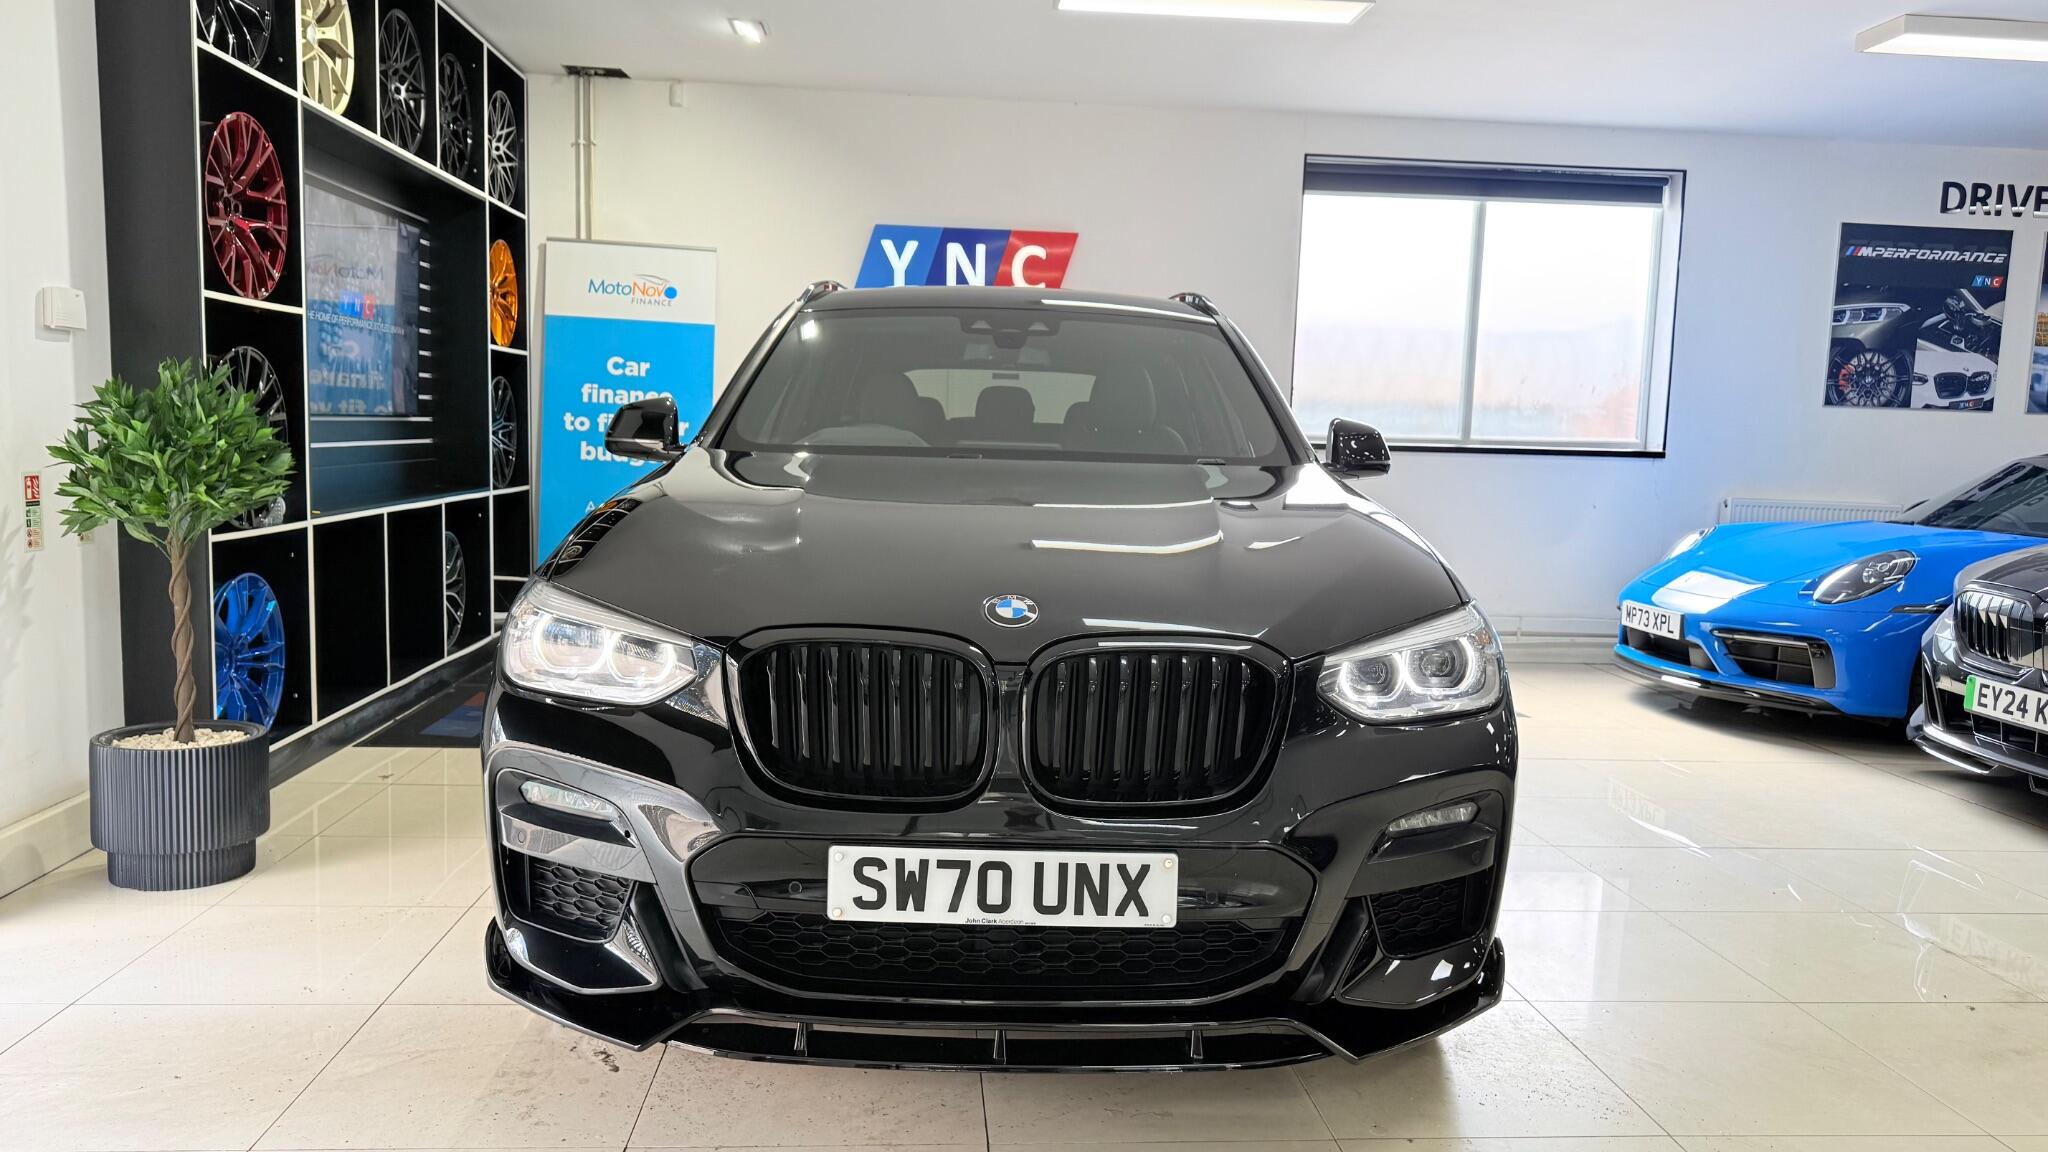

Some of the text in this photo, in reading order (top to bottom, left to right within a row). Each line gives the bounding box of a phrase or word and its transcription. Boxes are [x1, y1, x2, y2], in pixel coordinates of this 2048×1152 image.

[1940, 181, 2048, 218] DRIVE
[880, 239, 1047, 288] YNC
[1975, 277, 2000, 286] YNC
[631, 298, 672, 306] FINANCE
[607, 356, 650, 377] Car
[564, 412, 590, 431] to
[1625, 604, 1674, 634] MP73 XPL
[1977, 683, 2029, 719] EY24
[853, 857, 1151, 917] SW70 UNX
